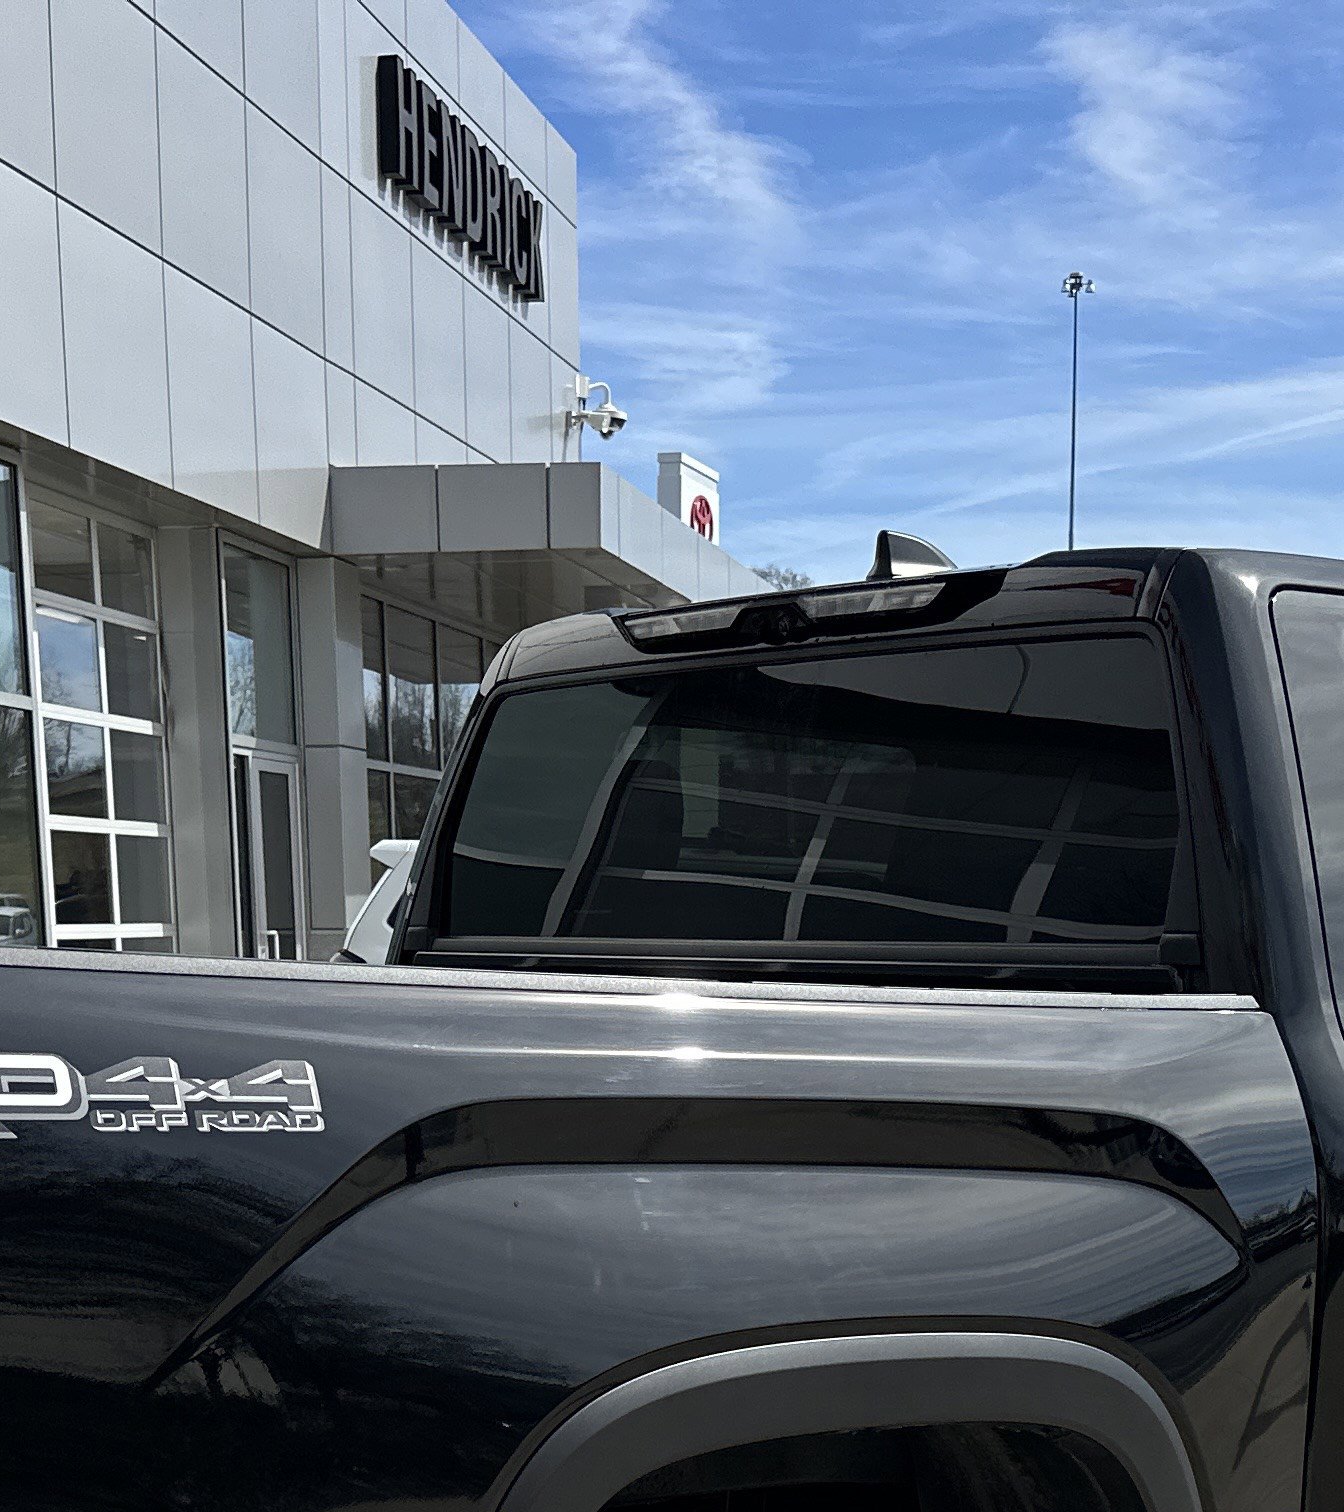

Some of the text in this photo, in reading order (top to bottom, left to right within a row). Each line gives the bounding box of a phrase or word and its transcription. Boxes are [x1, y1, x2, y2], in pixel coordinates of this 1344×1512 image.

[378, 55, 544, 302] HENDRICK
[91, 1109, 325, 1133] OFF ROAD
